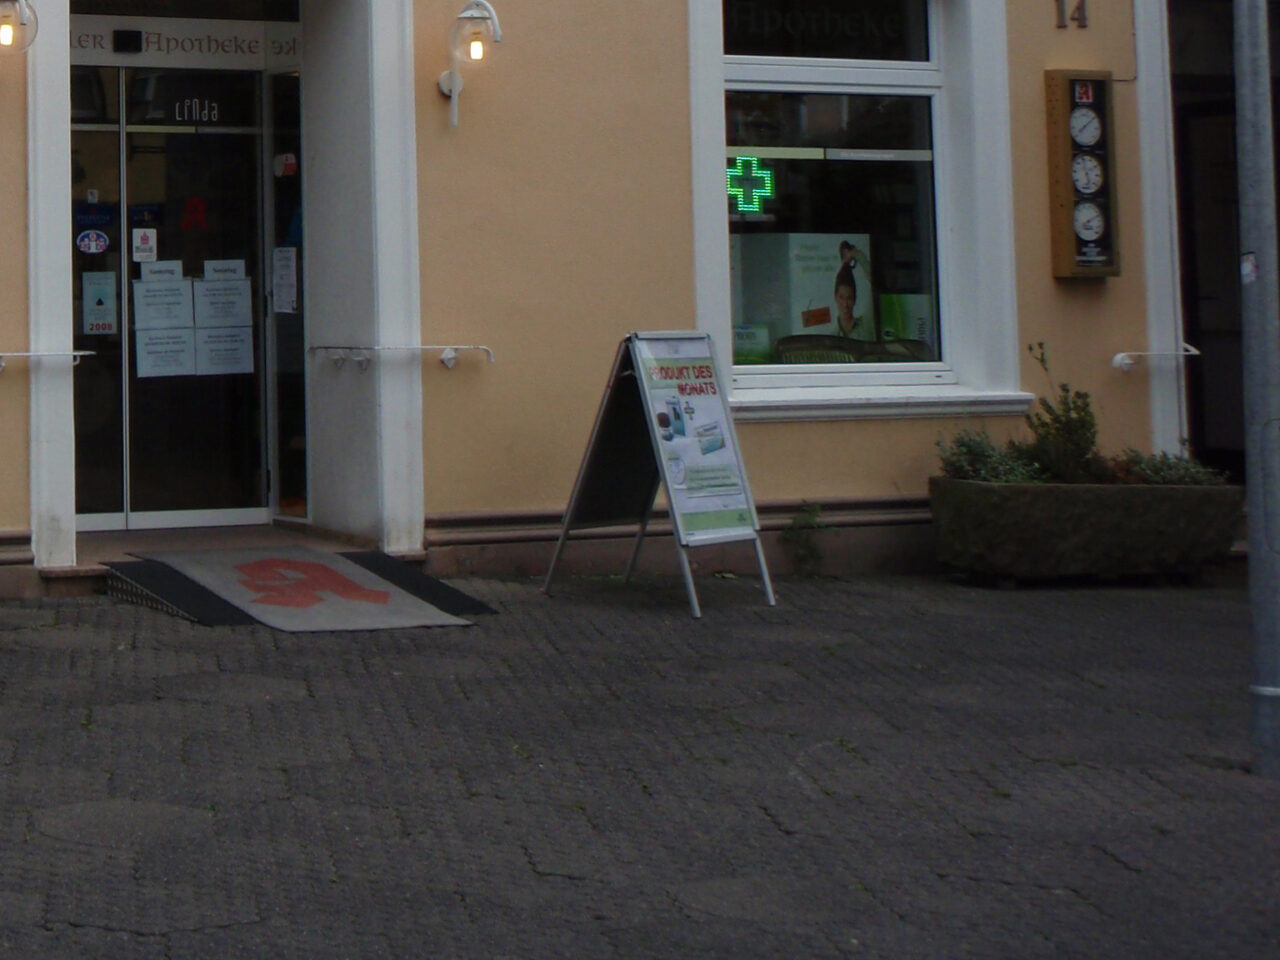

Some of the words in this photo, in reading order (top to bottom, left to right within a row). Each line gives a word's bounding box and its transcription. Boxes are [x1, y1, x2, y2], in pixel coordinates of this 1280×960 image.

[144, 31, 260, 56] Apotheke
[692, 365, 713, 379] DES
[677, 381, 717, 396] MONATS
